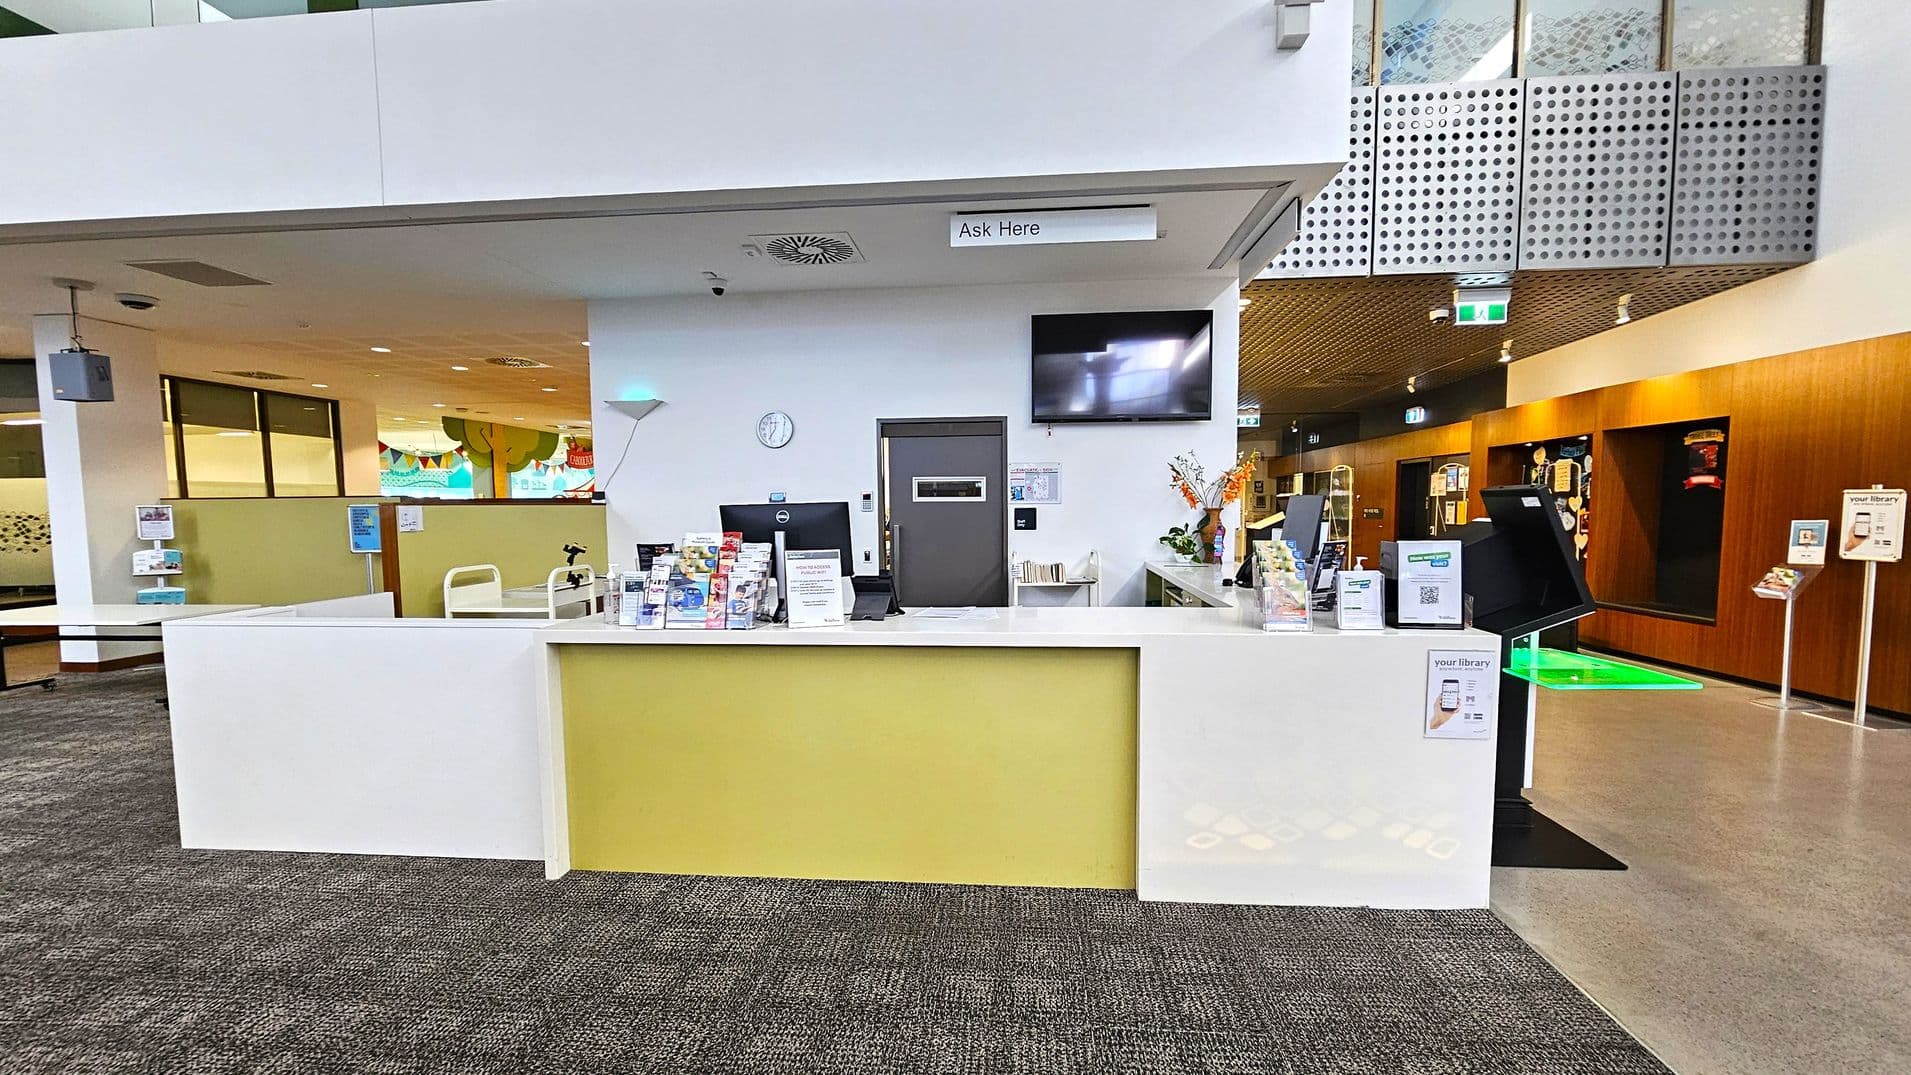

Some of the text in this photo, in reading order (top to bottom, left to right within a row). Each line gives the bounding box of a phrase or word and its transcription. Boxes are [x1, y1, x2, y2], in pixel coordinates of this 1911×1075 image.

[959, 220, 1040, 238] Ask Here
[1871, 495, 1899, 504] library
[1434, 658, 1490, 667] your library
